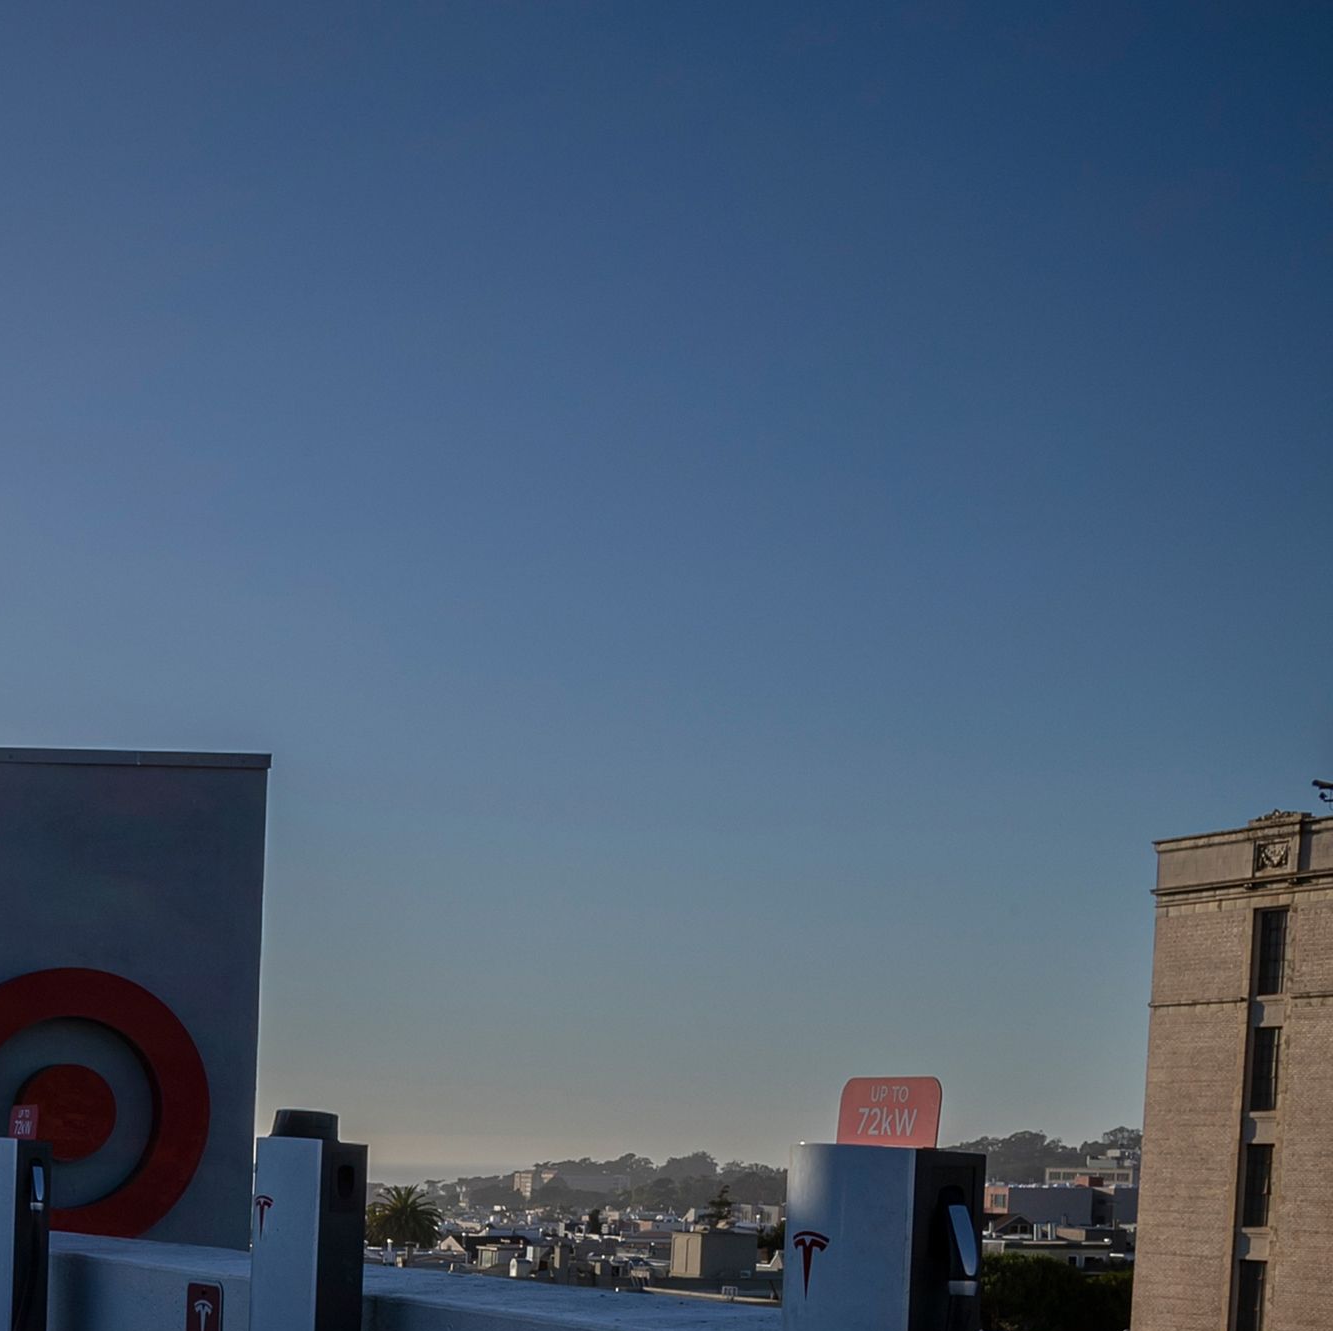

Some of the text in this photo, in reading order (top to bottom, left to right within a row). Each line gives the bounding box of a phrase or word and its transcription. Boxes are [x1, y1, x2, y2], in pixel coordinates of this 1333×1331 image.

[871, 1085, 909, 1103] UP TO
[14, 1119, 33, 1135] 72kW
[856, 1106, 918, 1137] 72kW
